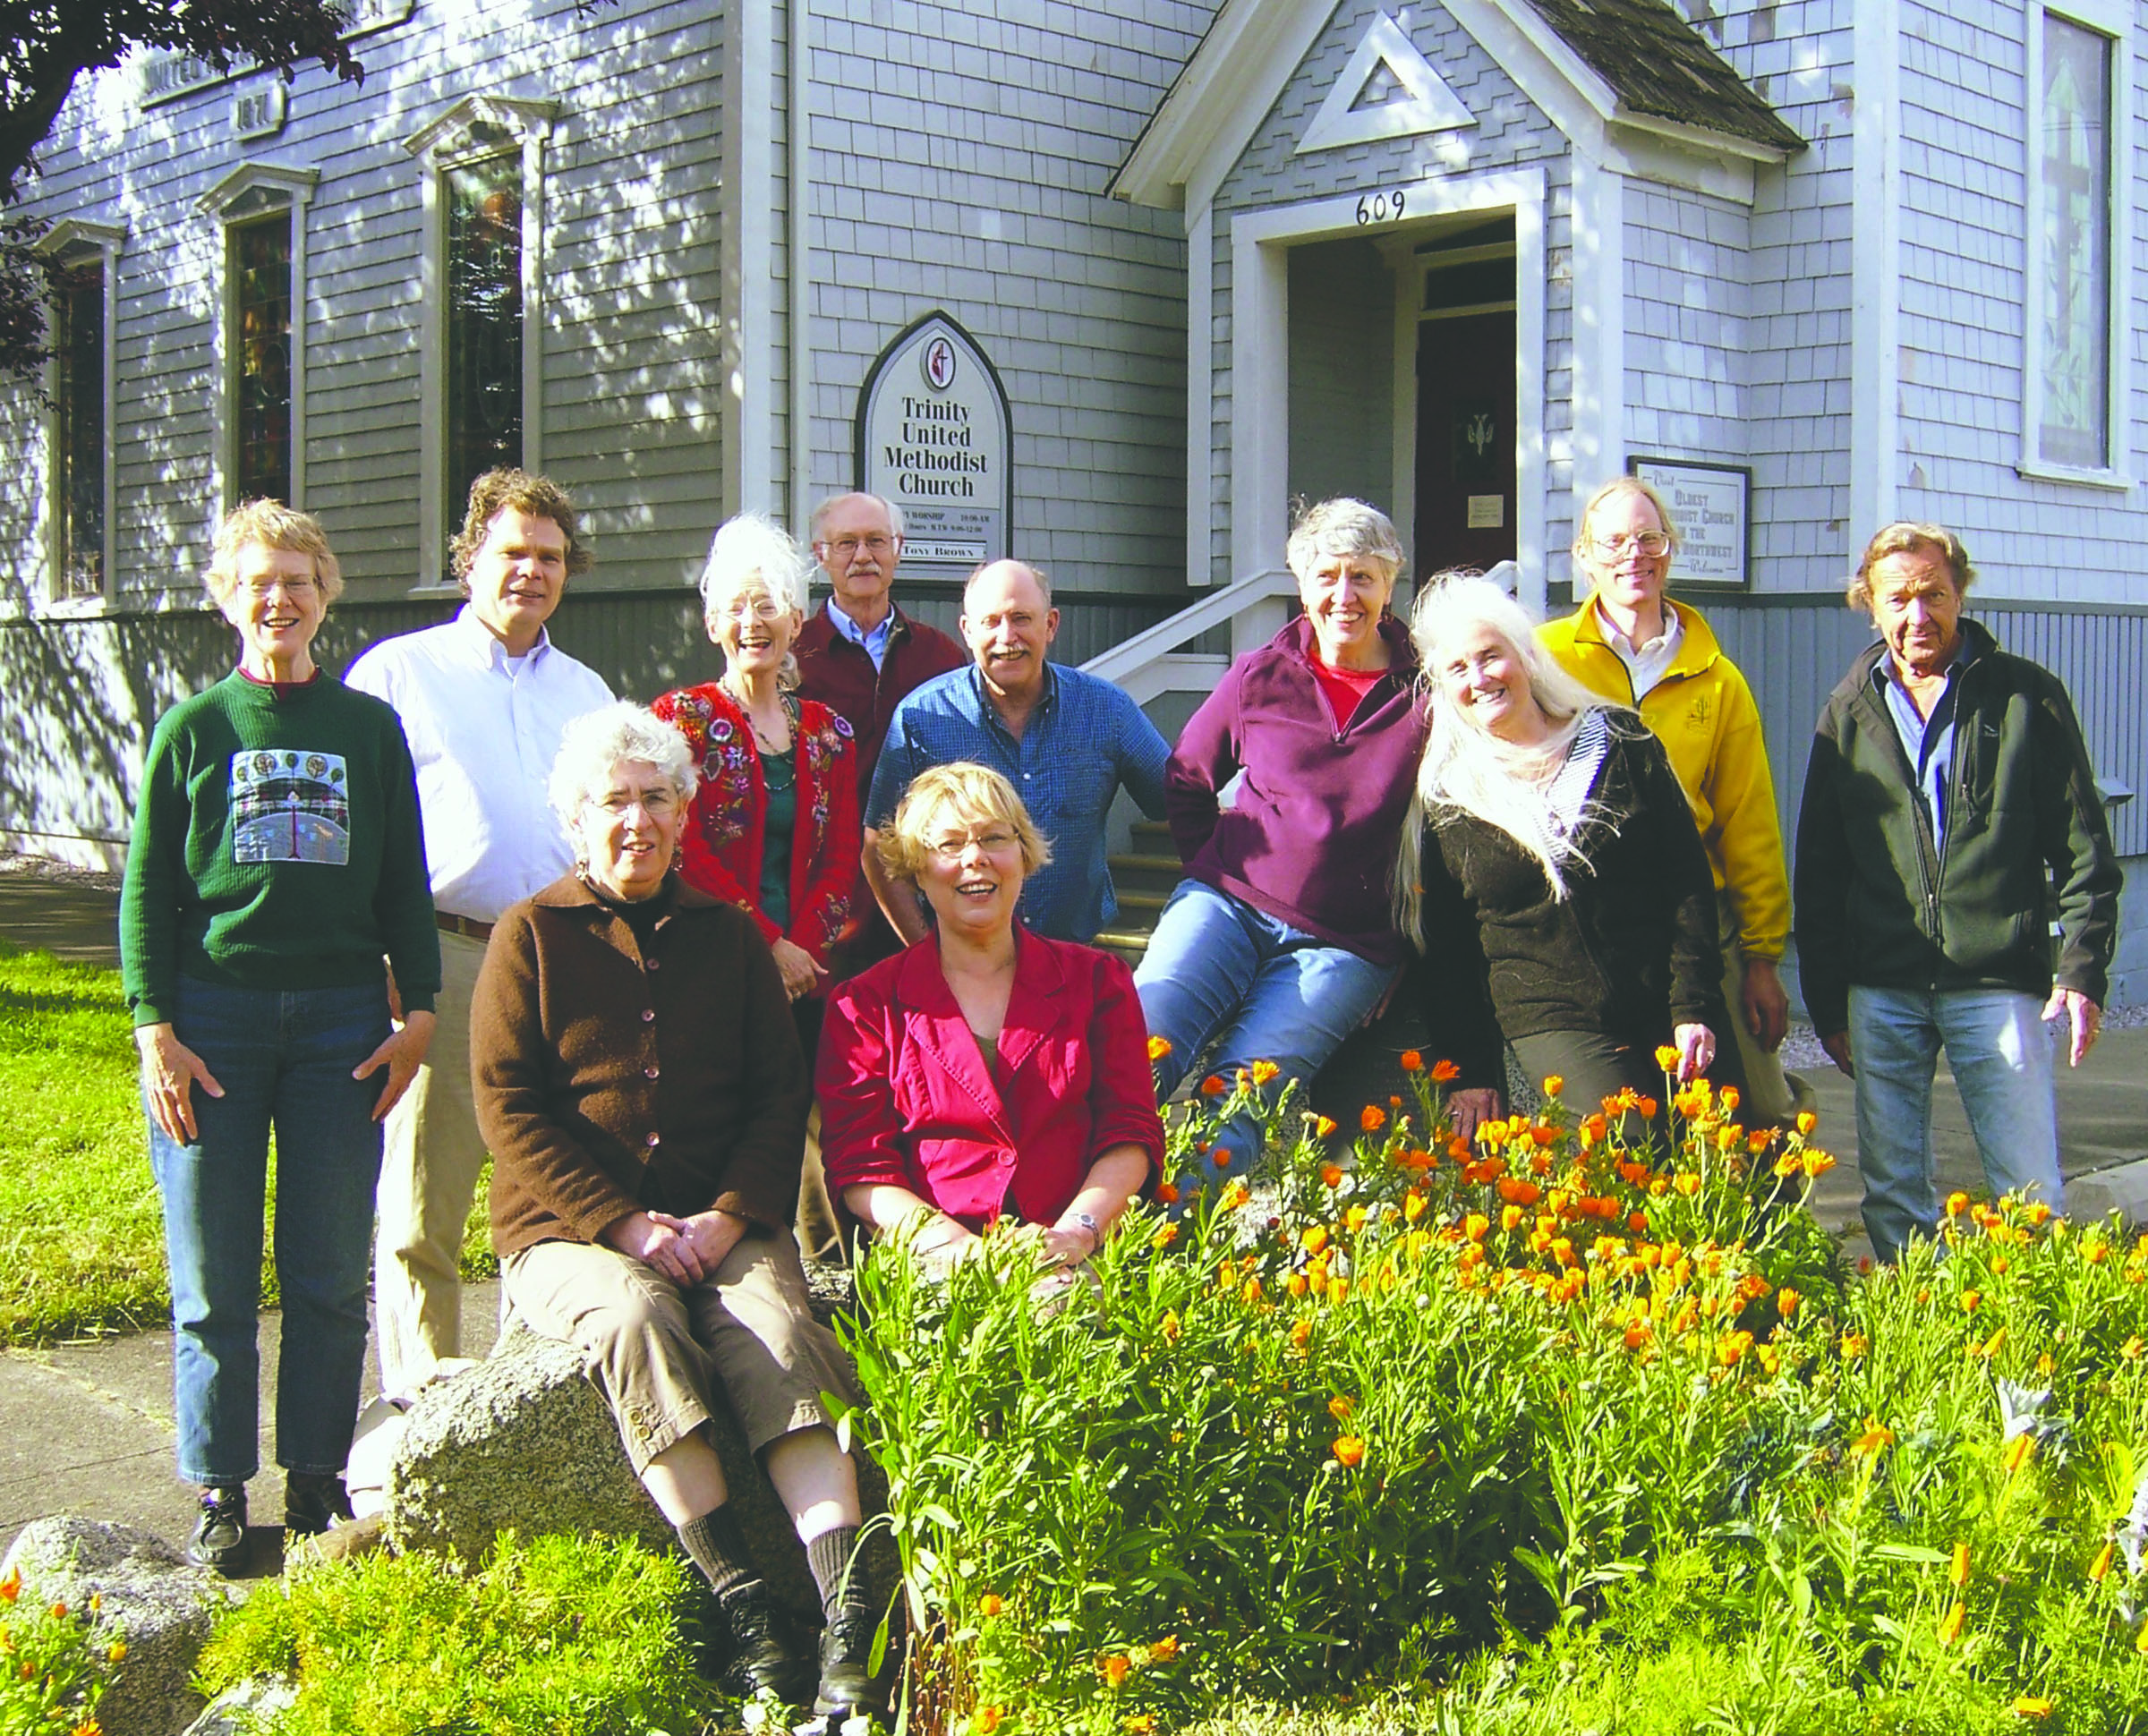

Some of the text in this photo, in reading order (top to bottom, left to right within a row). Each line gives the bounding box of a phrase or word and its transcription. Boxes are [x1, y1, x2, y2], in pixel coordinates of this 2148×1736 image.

[1356, 191, 1405, 226] 609
[902, 396, 971, 427] Trinity
[902, 422, 971, 447] United
[883, 447, 988, 473] Methodist
[899, 472, 974, 497] Church
[911, 511, 946, 521] WORSHIP
